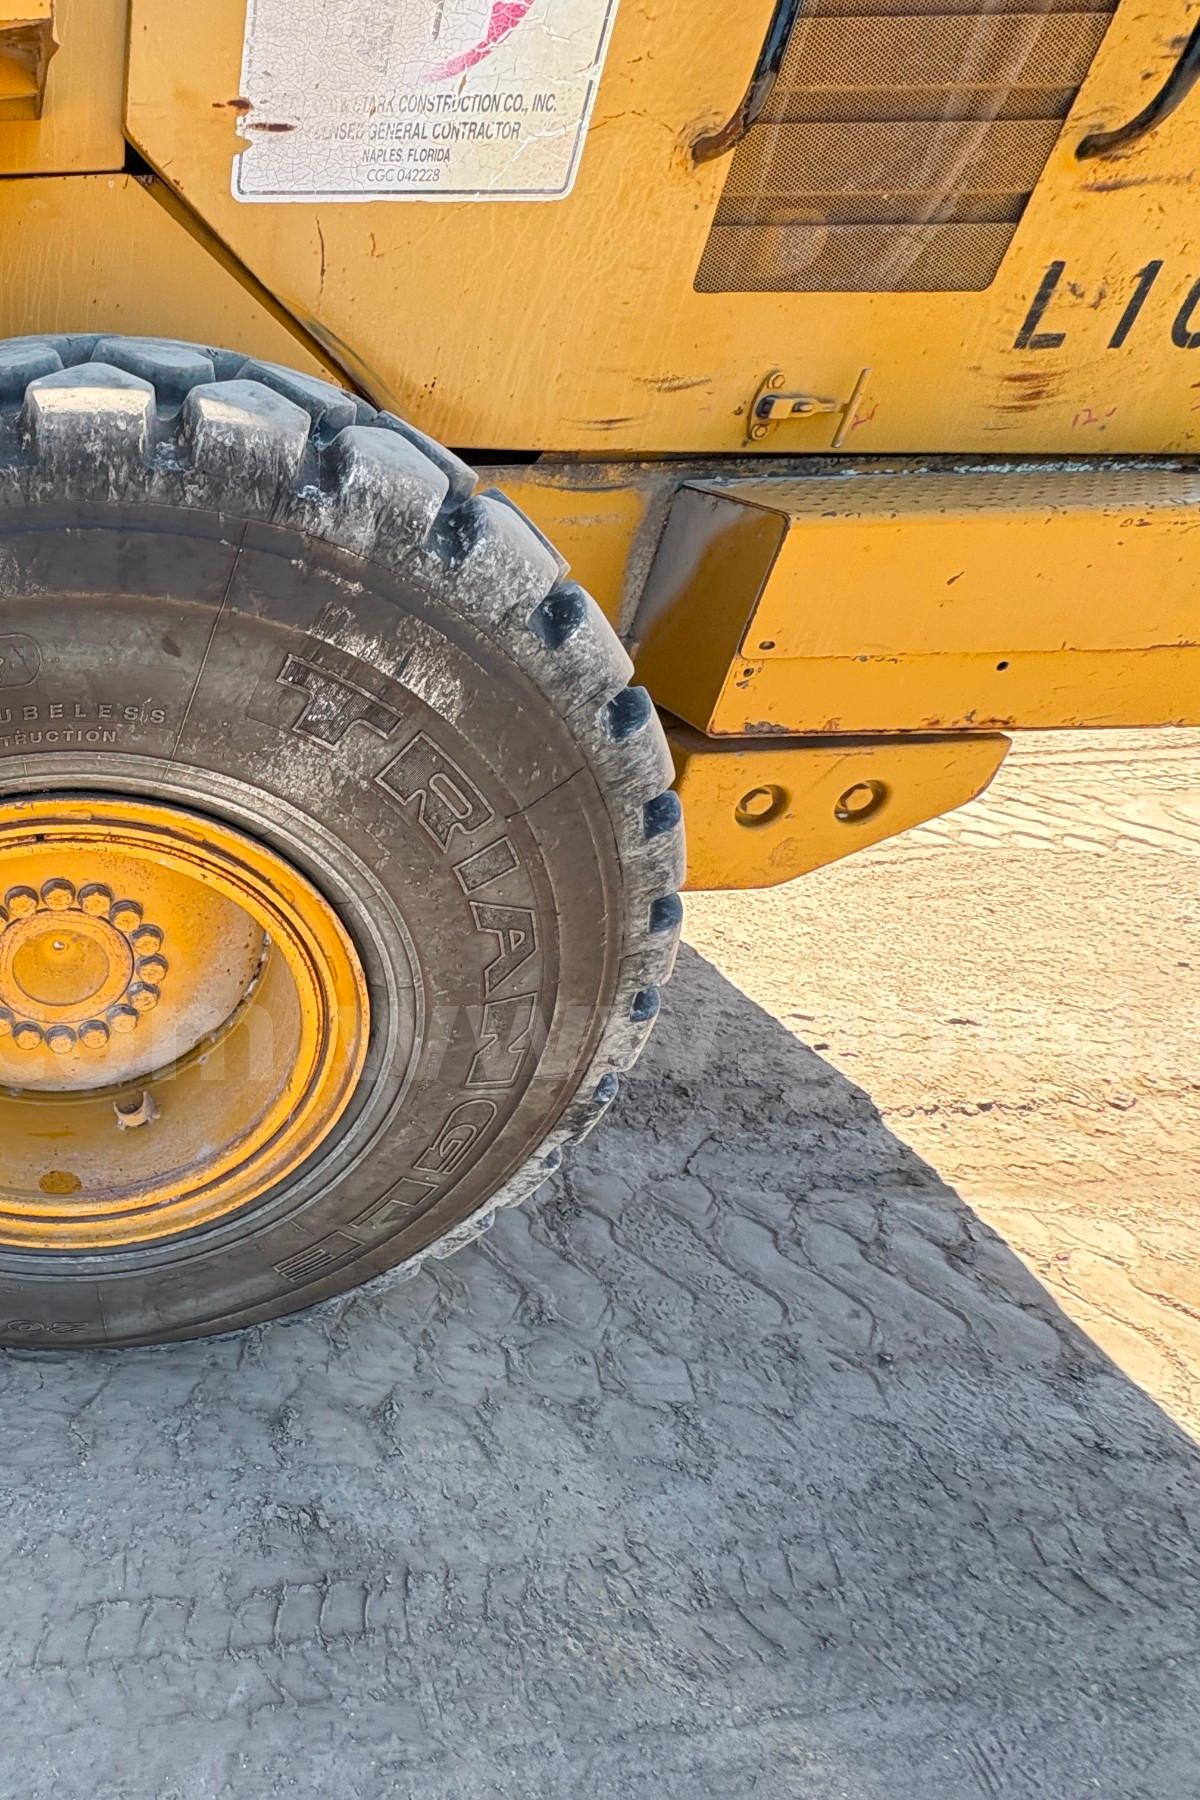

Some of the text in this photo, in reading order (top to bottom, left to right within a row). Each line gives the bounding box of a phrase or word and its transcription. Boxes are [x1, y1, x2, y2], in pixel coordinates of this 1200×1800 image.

[399, 94, 501, 113] CONSTRUCTION
[531, 94, 557, 113] INC.
[369, 121, 429, 140] GENERAL
[432, 121, 522, 140] CONTRACTOR
[407, 148, 451, 163] FLORIDA
[366, 168, 440, 182] CGC 042228
[273, 652, 538, 1283] TRIANGLE
